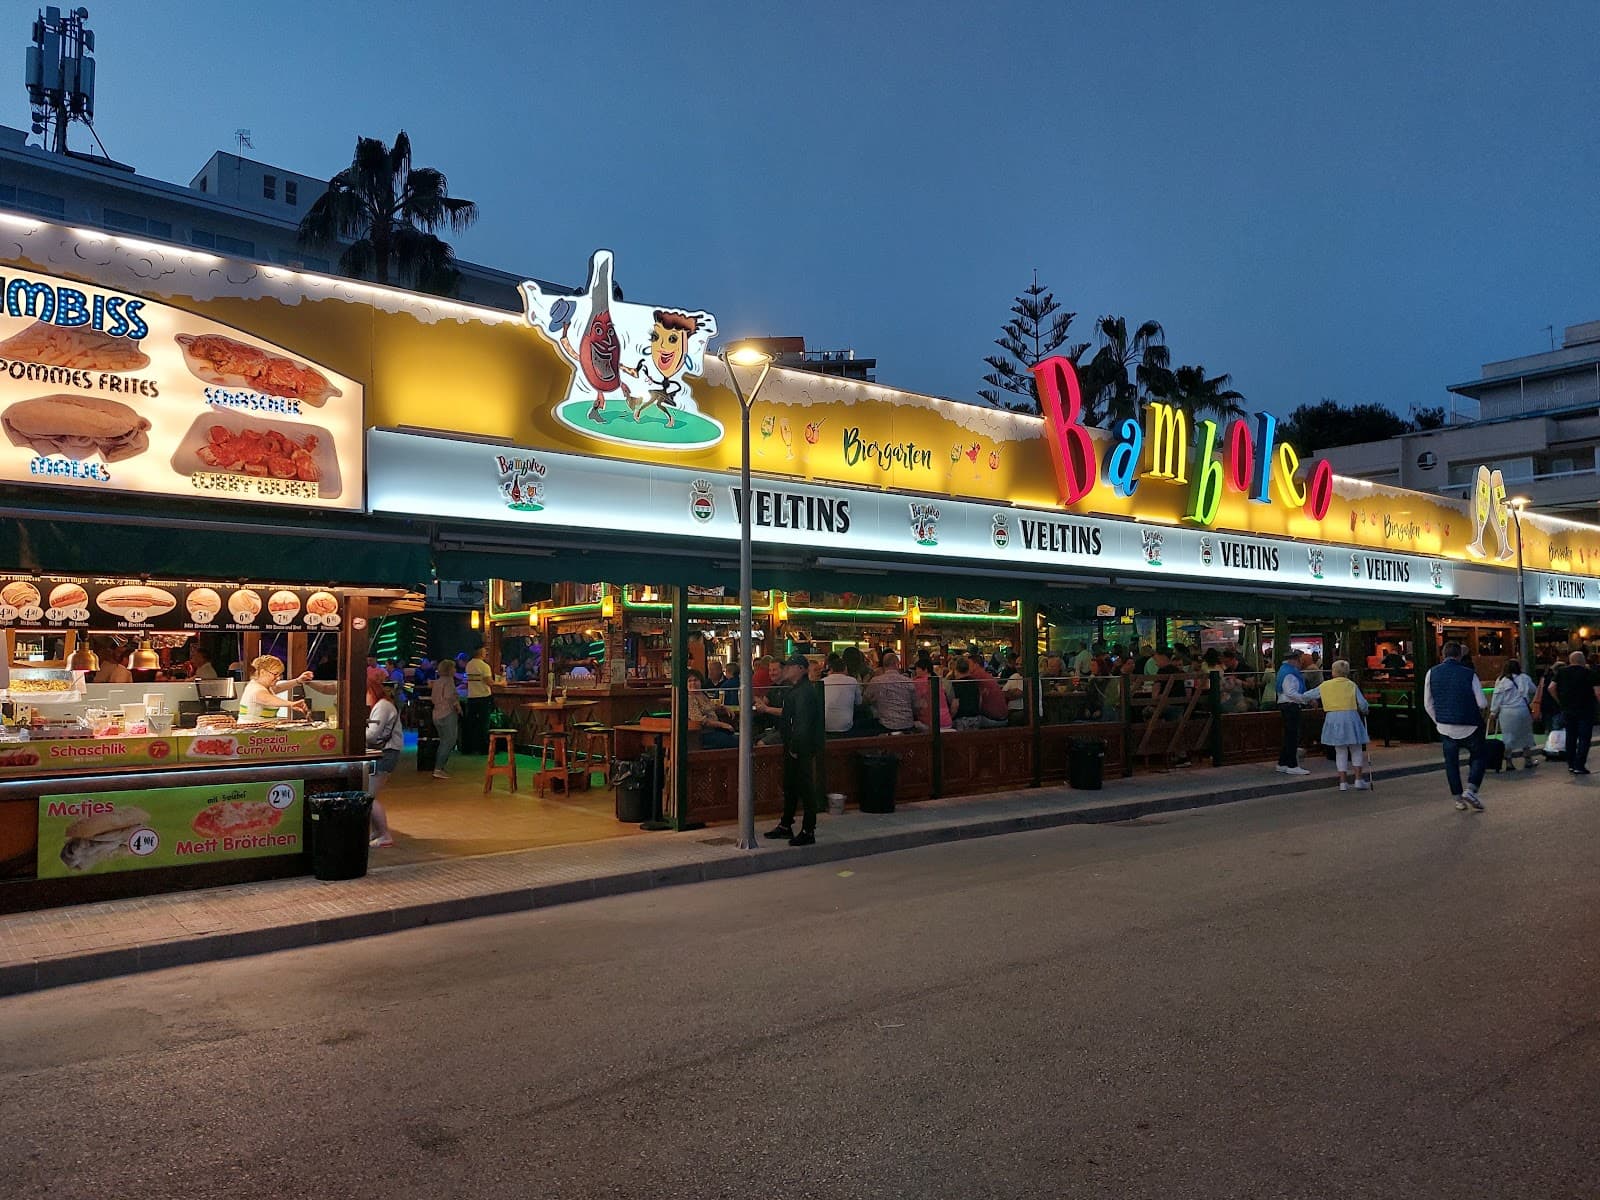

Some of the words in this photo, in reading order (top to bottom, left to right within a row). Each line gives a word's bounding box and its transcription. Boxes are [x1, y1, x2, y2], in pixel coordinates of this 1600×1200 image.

[99, 373, 160, 398] FRITES
[843, 427, 932, 471] Biergarten
[1027, 355, 1333, 526] Bamboleo
[192, 471, 252, 493] CURRY
[731, 488, 851, 534] VELTINS
[1020, 519, 1102, 556] VELTINS
[1220, 541, 1279, 571] VELTINS
[1366, 558, 1410, 583] VELTINS
[1558, 580, 1586, 599] VELTINS
[50, 743, 127, 758] Schaschlik
[236, 746, 266, 756] Curry
[269, 743, 301, 753] Wurst
[249, 734, 288, 747] Spezial
[48, 800, 114, 817] Matjes
[176, 839, 219, 856] Mett
[223, 834, 297, 851] Brötchen
